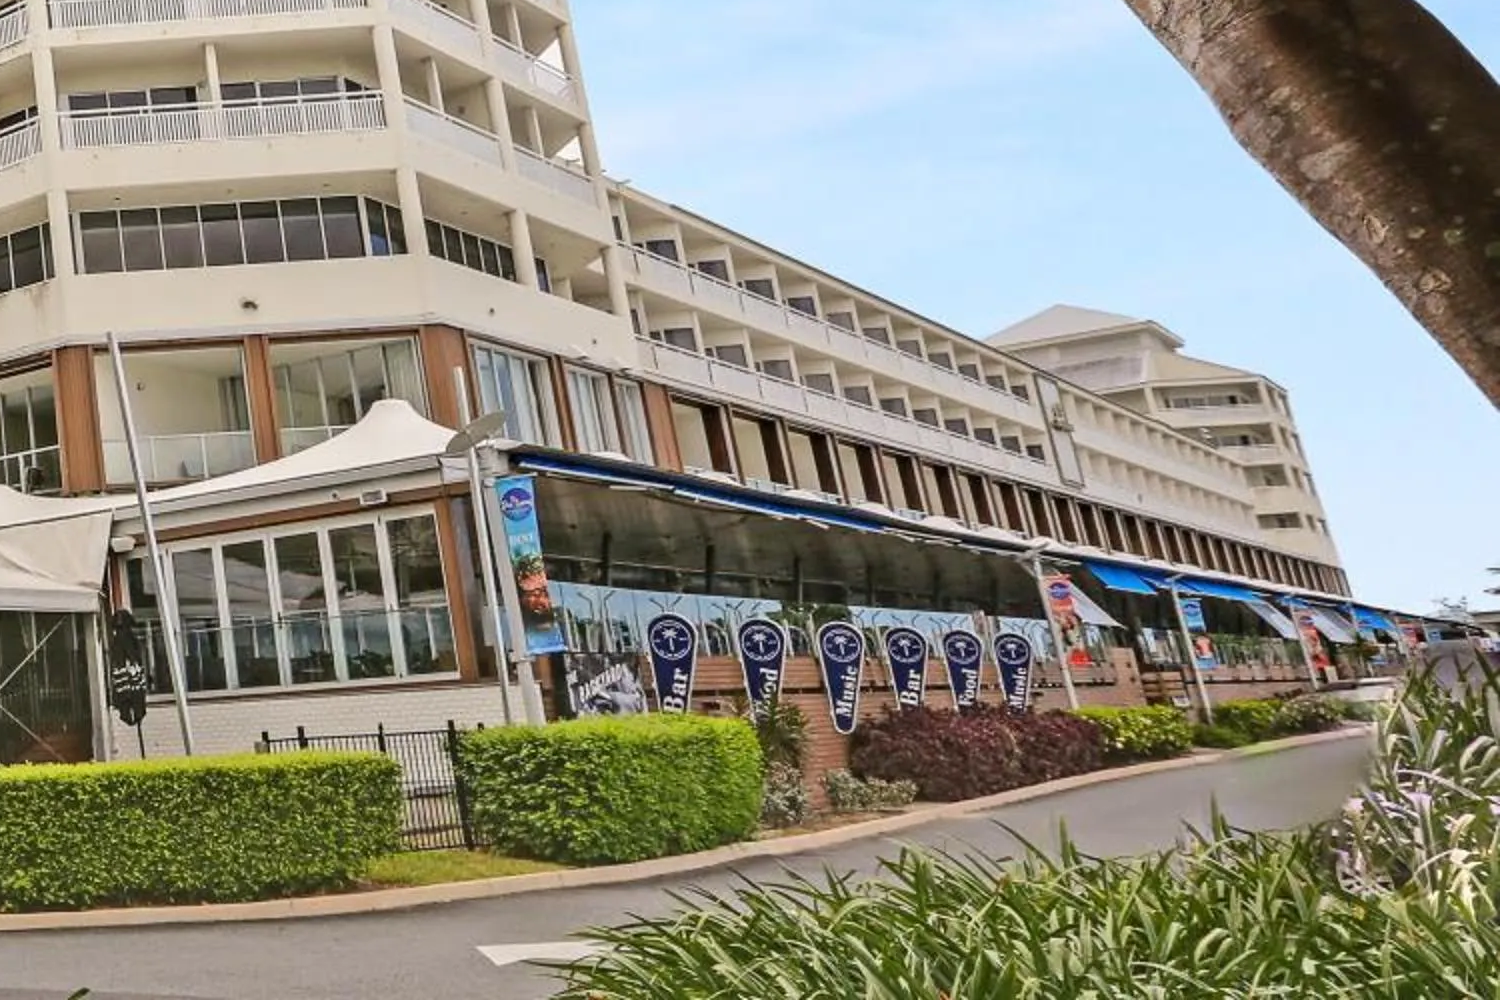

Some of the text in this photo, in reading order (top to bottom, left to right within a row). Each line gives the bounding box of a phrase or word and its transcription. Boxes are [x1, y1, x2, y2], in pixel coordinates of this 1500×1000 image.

[663, 667, 689, 713] Bar
[835, 666, 858, 717] Music
[900, 669, 921, 706] Bar
[958, 668, 977, 706] Food
[1009, 667, 1027, 709] Music
